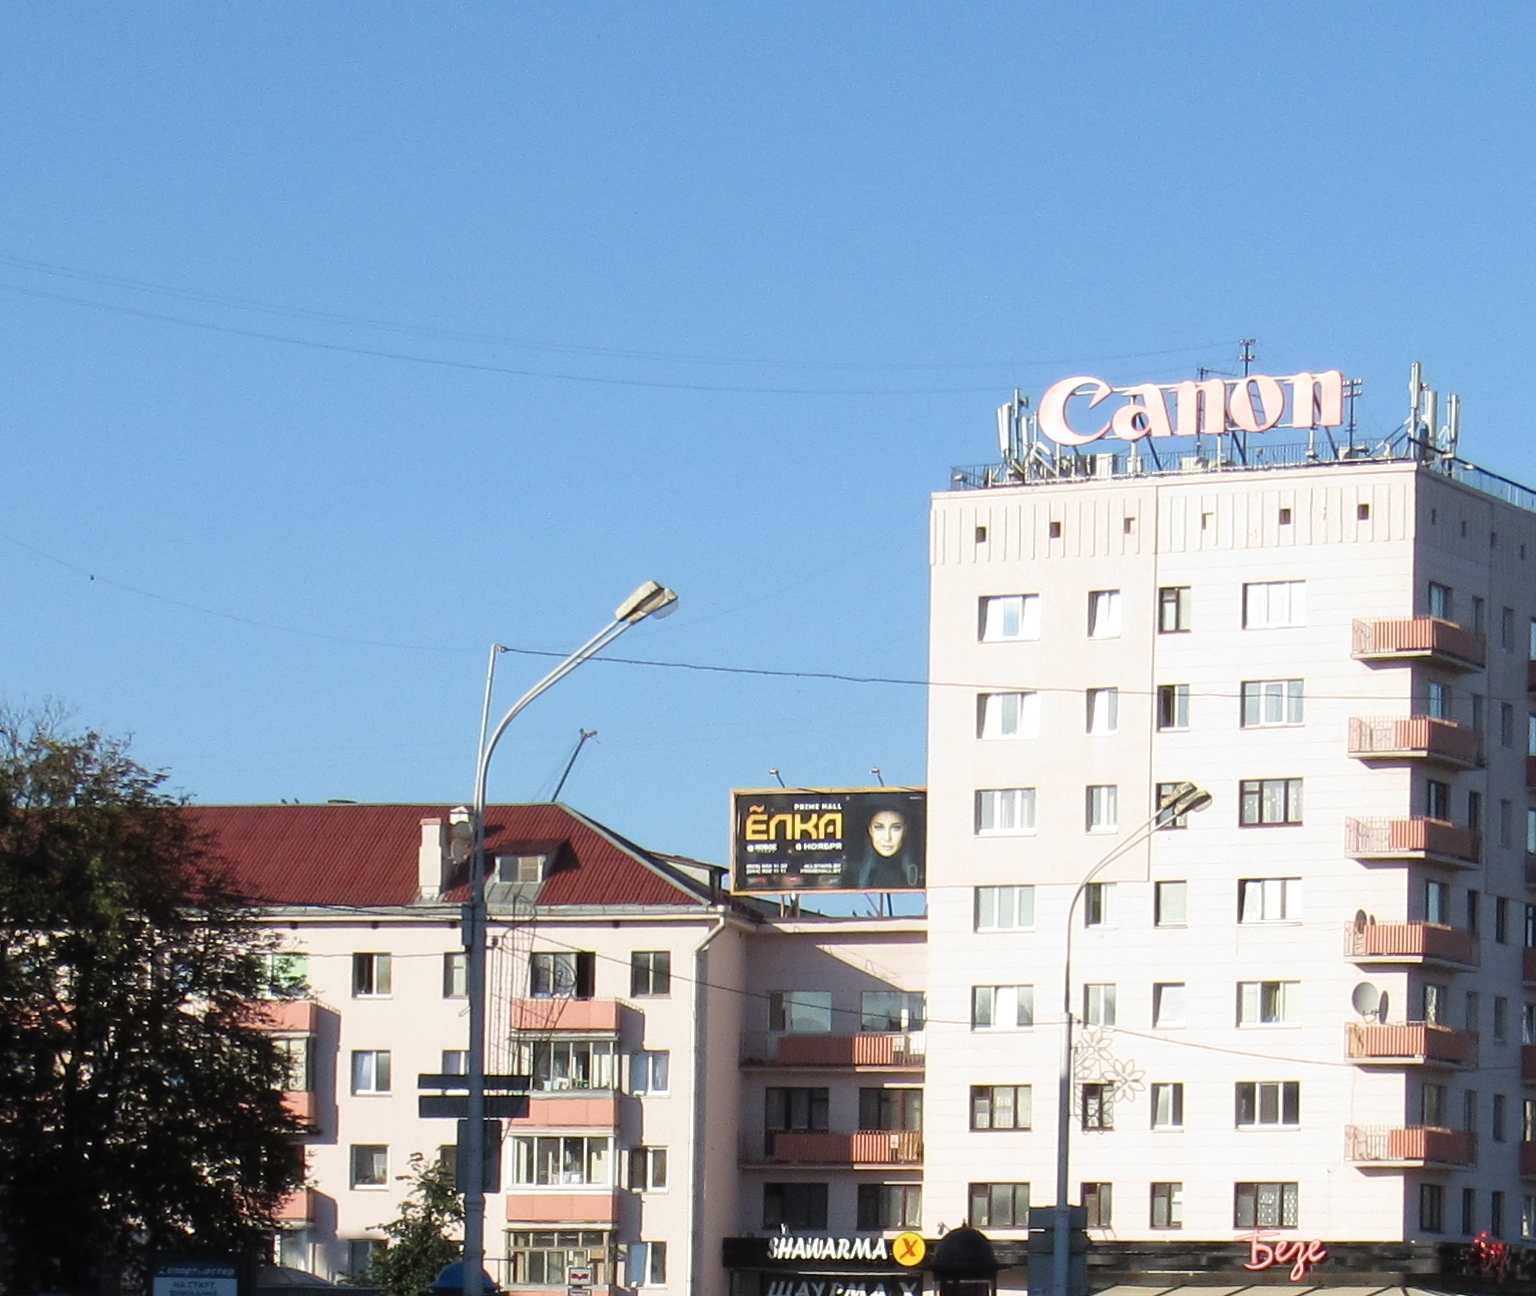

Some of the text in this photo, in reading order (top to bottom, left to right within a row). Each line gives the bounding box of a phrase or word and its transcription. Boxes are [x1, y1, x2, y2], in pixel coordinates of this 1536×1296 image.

[1038, 370, 1343, 446] Canon
[745, 804, 842, 840] ЁЛКА
[804, 842, 842, 850] НОЯБРЯ
[768, 1236, 888, 1260] SHAWARMA
[1234, 1229, 1327, 1282] Безе
